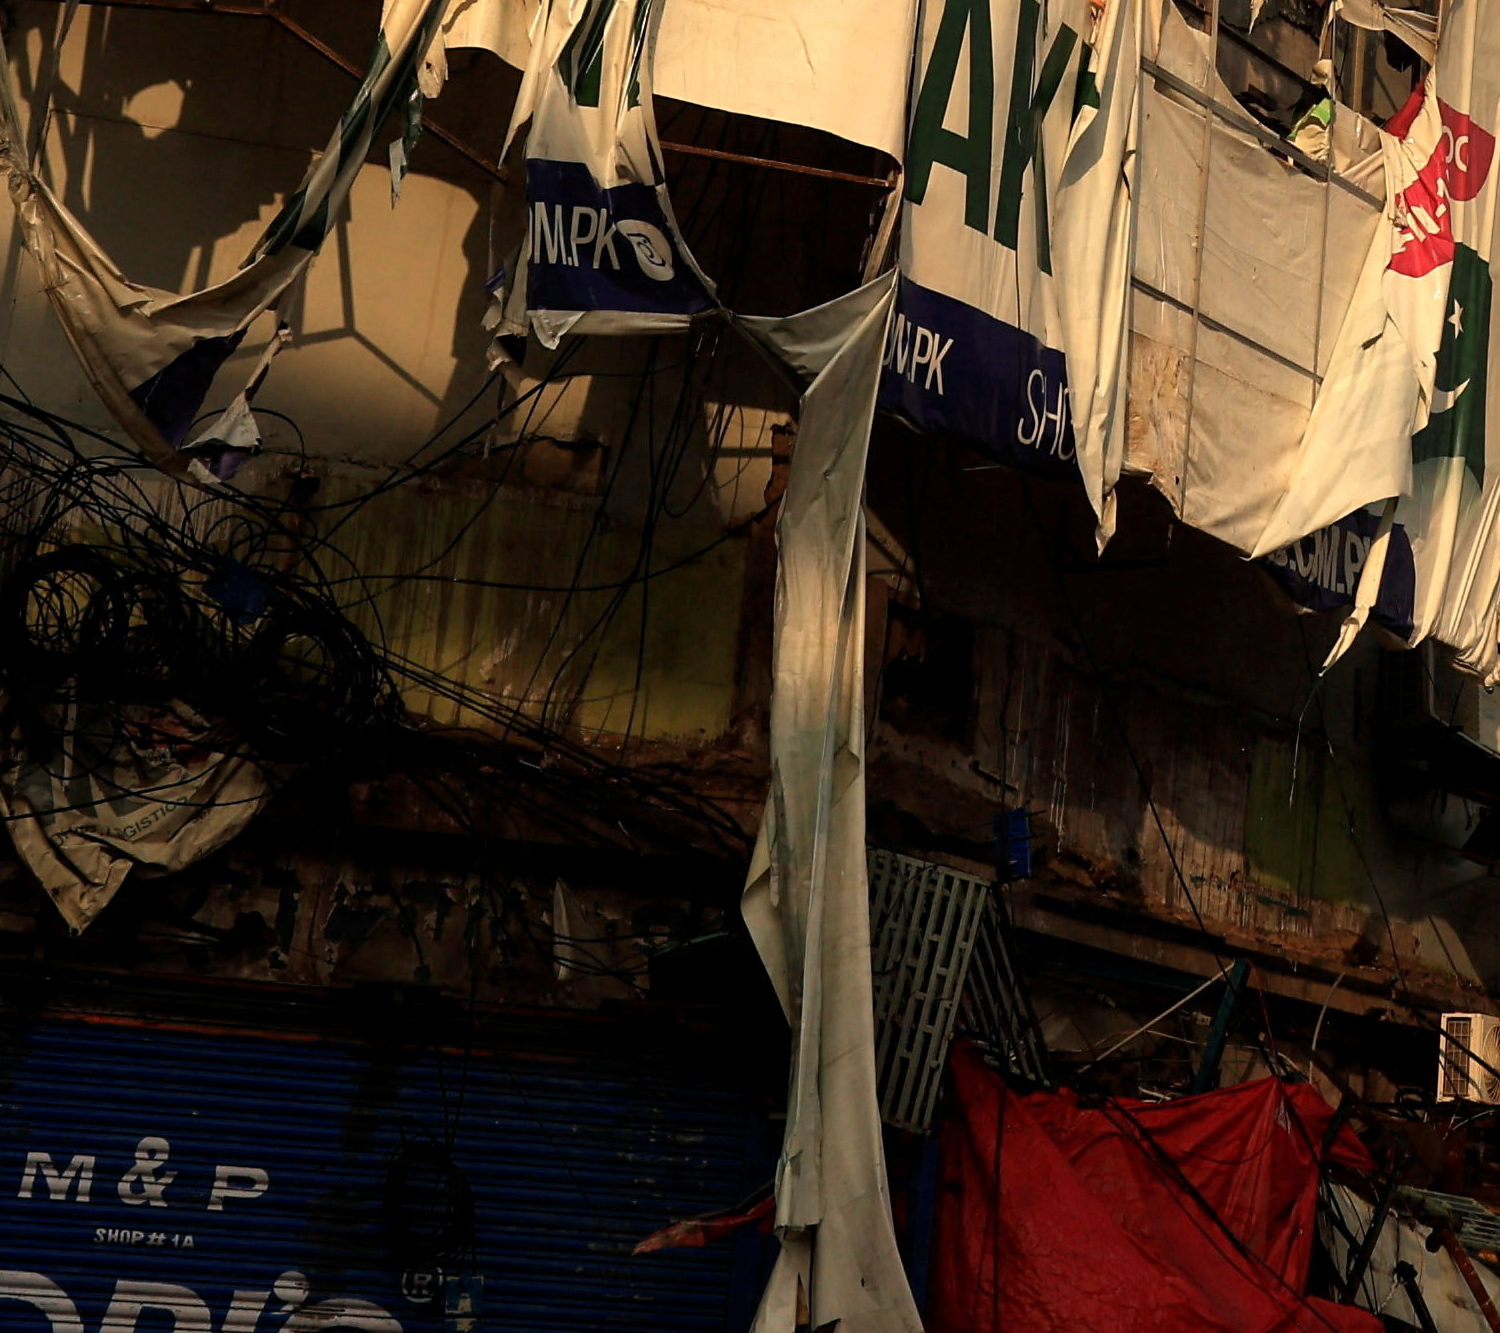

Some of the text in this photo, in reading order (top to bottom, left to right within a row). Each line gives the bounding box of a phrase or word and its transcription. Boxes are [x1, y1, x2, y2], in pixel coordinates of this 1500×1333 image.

[17, 1135, 272, 1213] M & P
